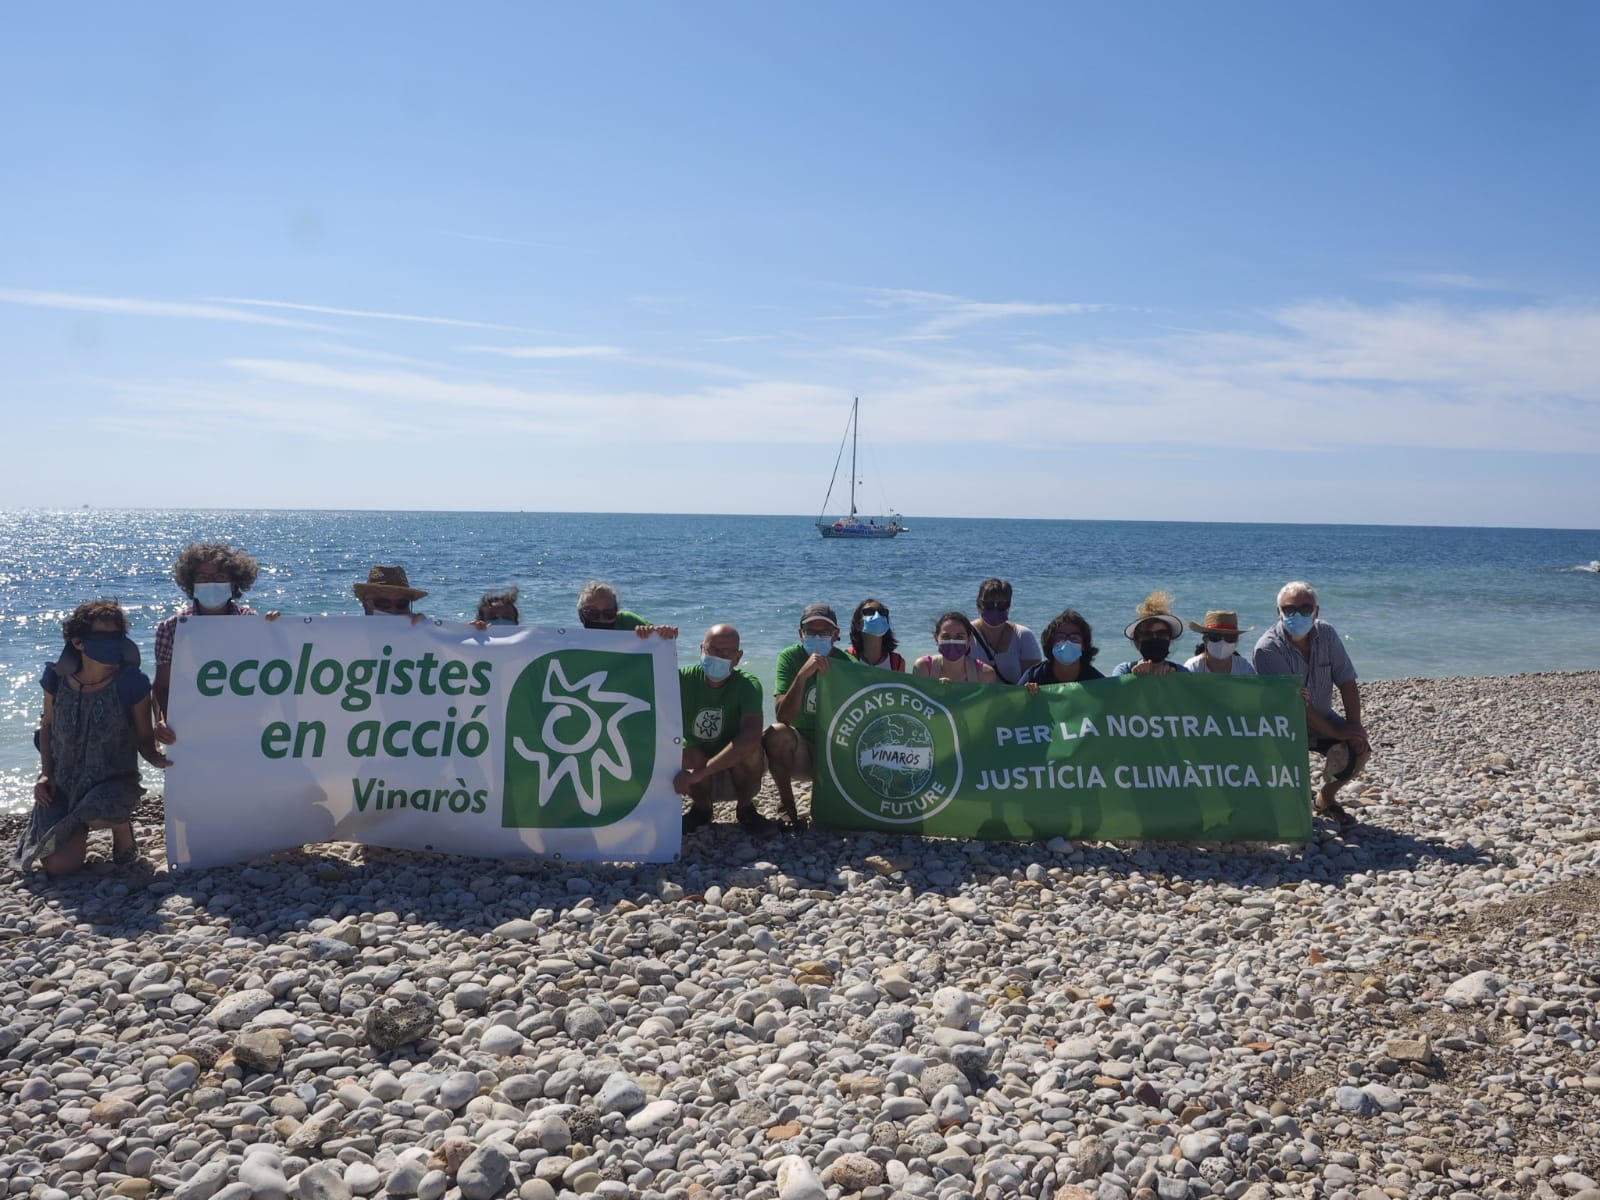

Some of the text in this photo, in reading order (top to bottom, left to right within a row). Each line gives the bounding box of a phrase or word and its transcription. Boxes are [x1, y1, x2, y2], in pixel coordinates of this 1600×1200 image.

[196, 643, 492, 712] ecologistes
[260, 705, 489, 759] en acció
[836, 692, 935, 747] FRIDAYS FOR
[996, 715, 1296, 746] PER LA NOSTRA LLAR,
[975, 760, 1301, 791] JUSTÍCIA CLIMÀTICA JA!
[352, 777, 487, 813] Vinaròs
[880, 781, 946, 815] FUTURE
